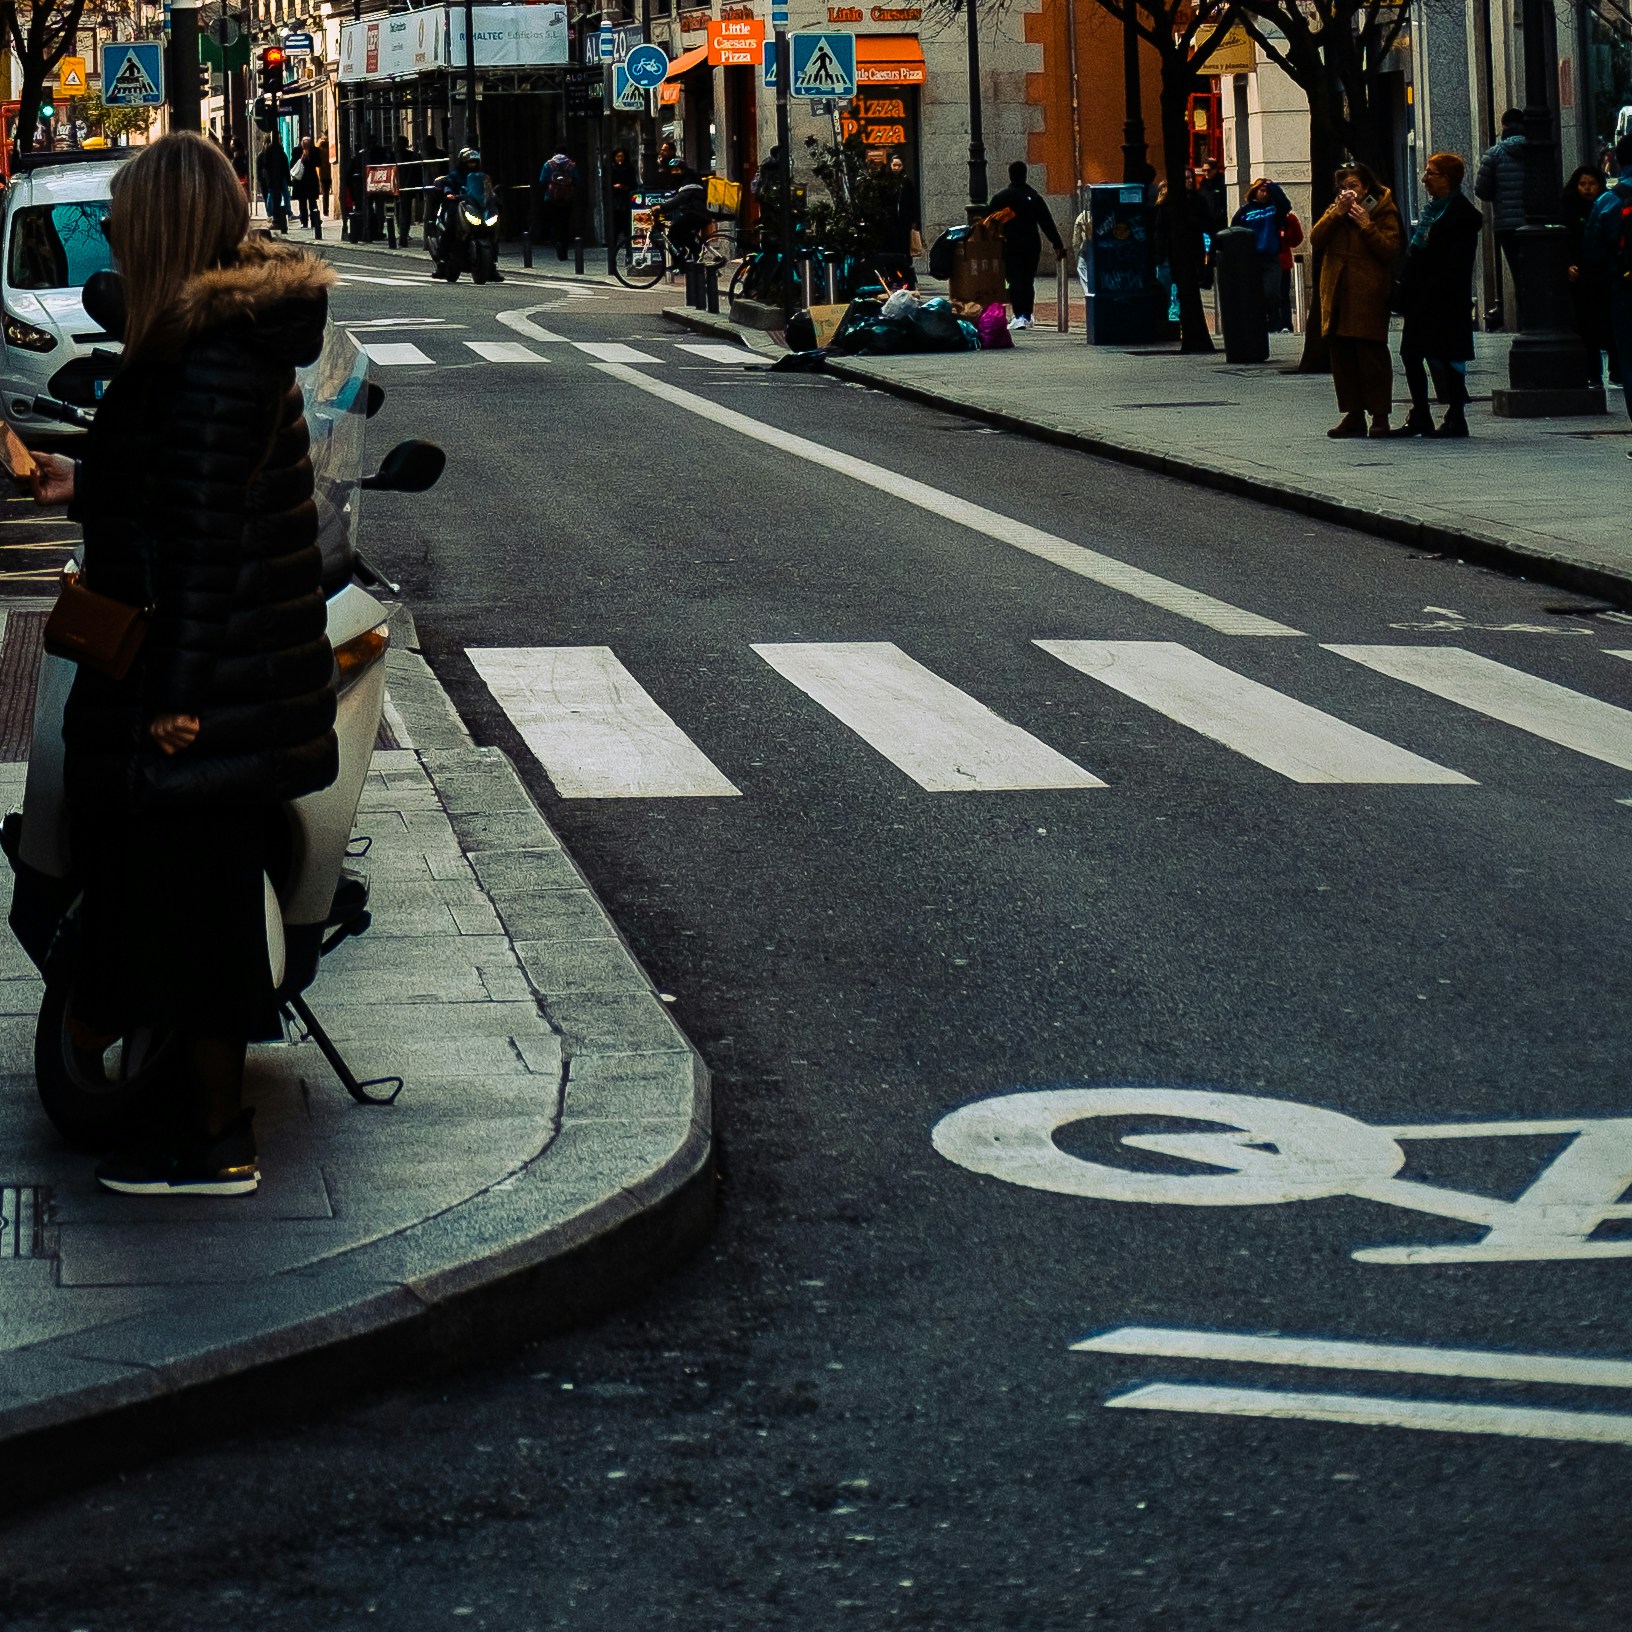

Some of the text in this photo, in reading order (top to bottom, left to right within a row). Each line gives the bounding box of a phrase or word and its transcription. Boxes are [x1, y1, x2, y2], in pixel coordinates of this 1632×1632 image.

[828, 5, 922, 23] Little Caesars
[721, 22, 751, 35] Little
[713, 36, 757, 49] Caesars
[720, 50, 751, 63] Pizza
[869, 68, 900, 81] Caesars
[900, 68, 923, 81] Pizza
